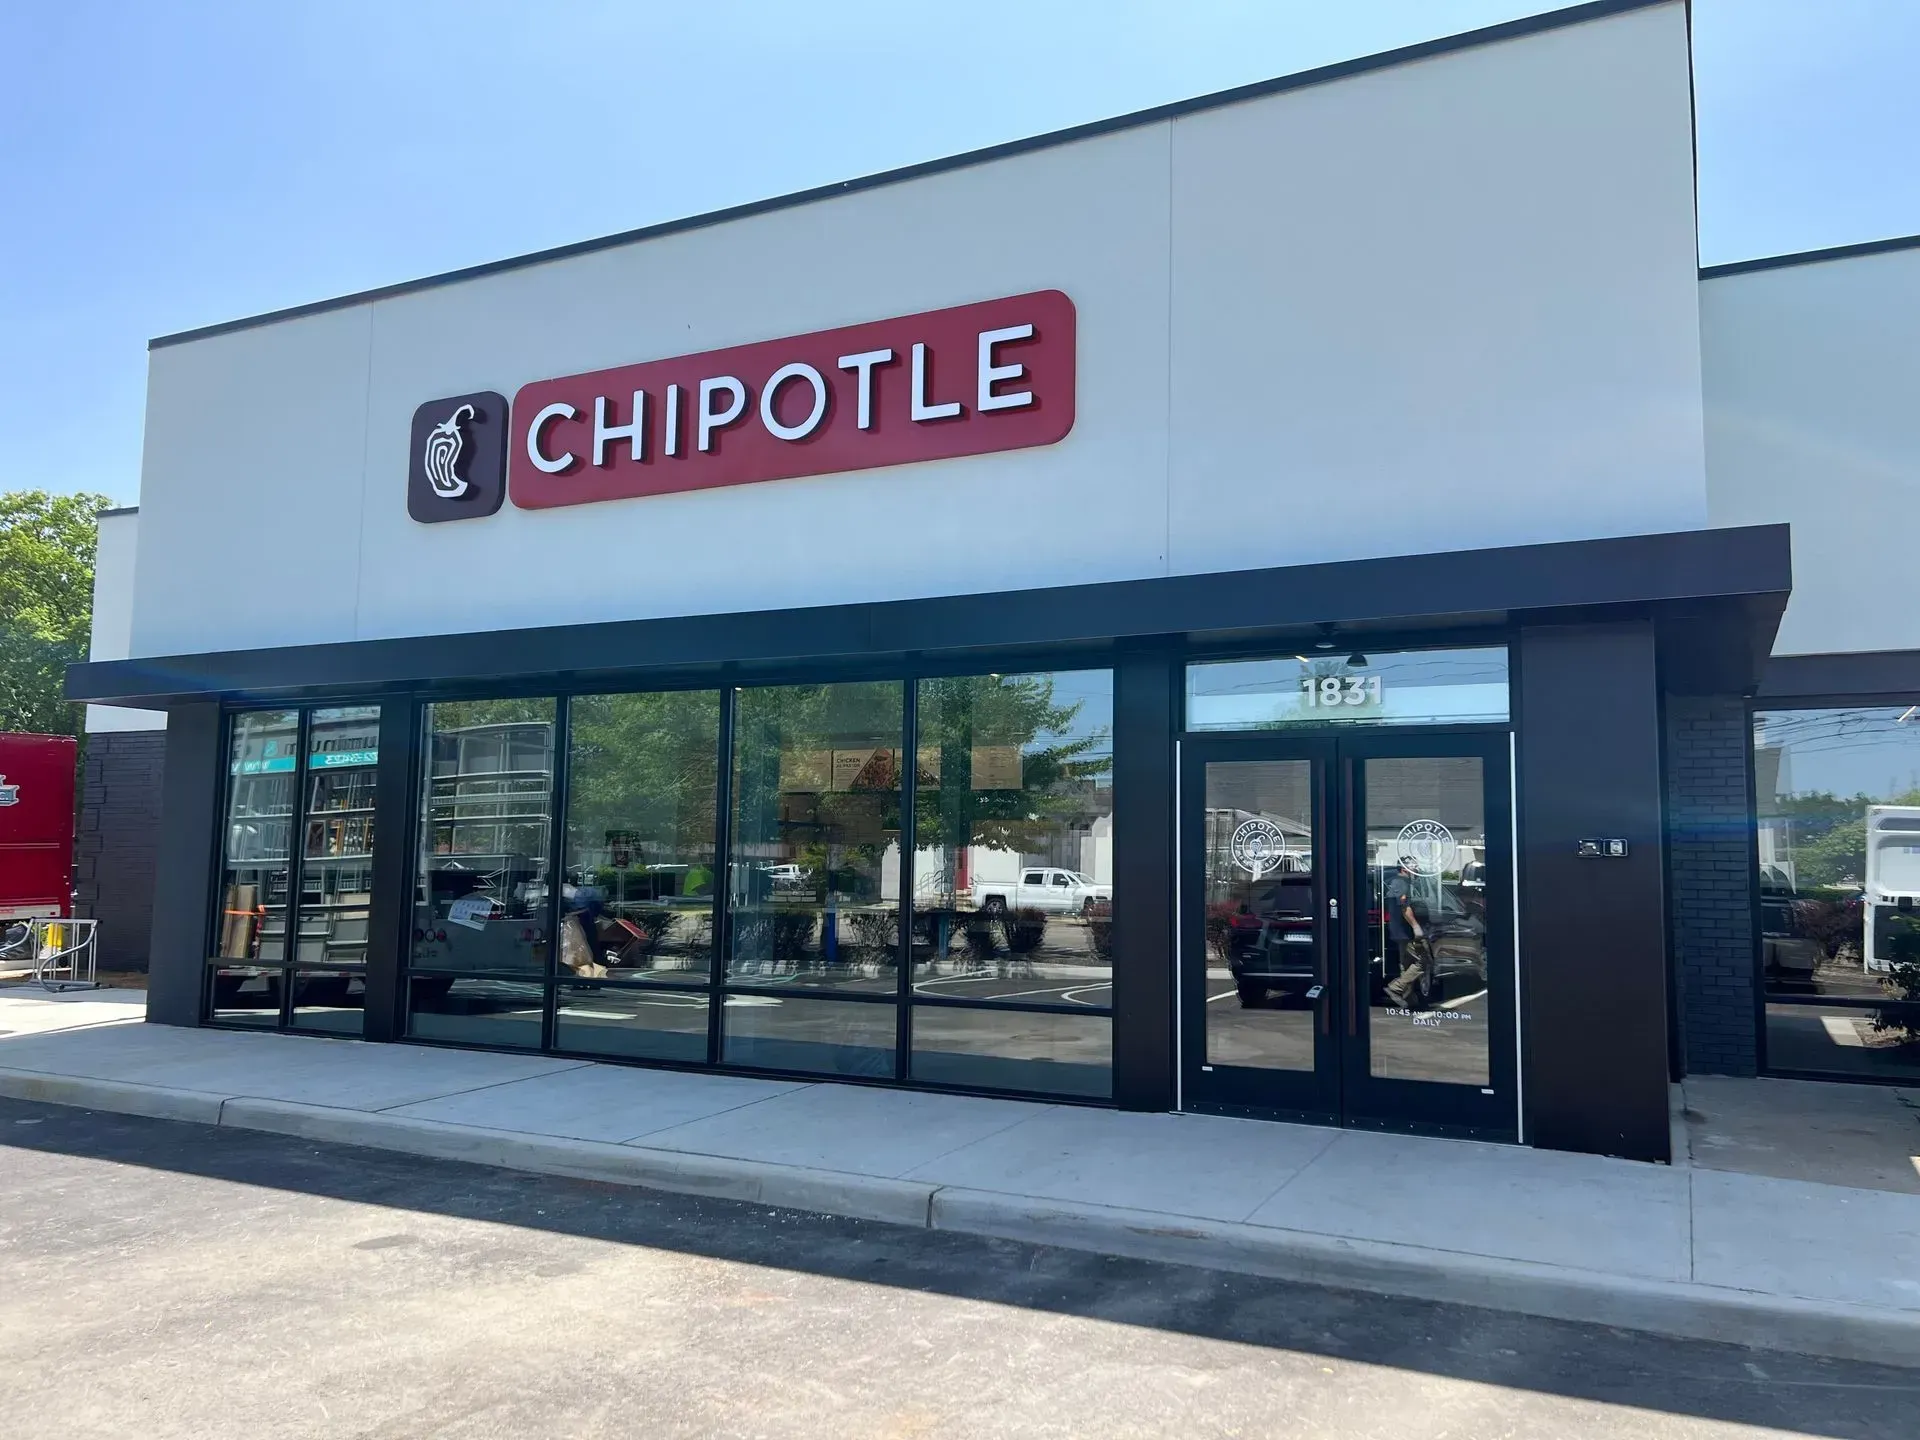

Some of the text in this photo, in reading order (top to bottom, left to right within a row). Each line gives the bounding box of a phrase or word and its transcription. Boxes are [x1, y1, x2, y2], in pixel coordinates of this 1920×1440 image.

[526, 323, 1034, 474] CHIPOTLE
[1302, 675, 1382, 707] 1831
[1236, 822, 1281, 843] CHIPOTLE
[1385, 1007, 1411, 1017] 10:45
[1432, 1010, 1459, 1020] 10:00
[1413, 1018, 1441, 1026] DAILY
